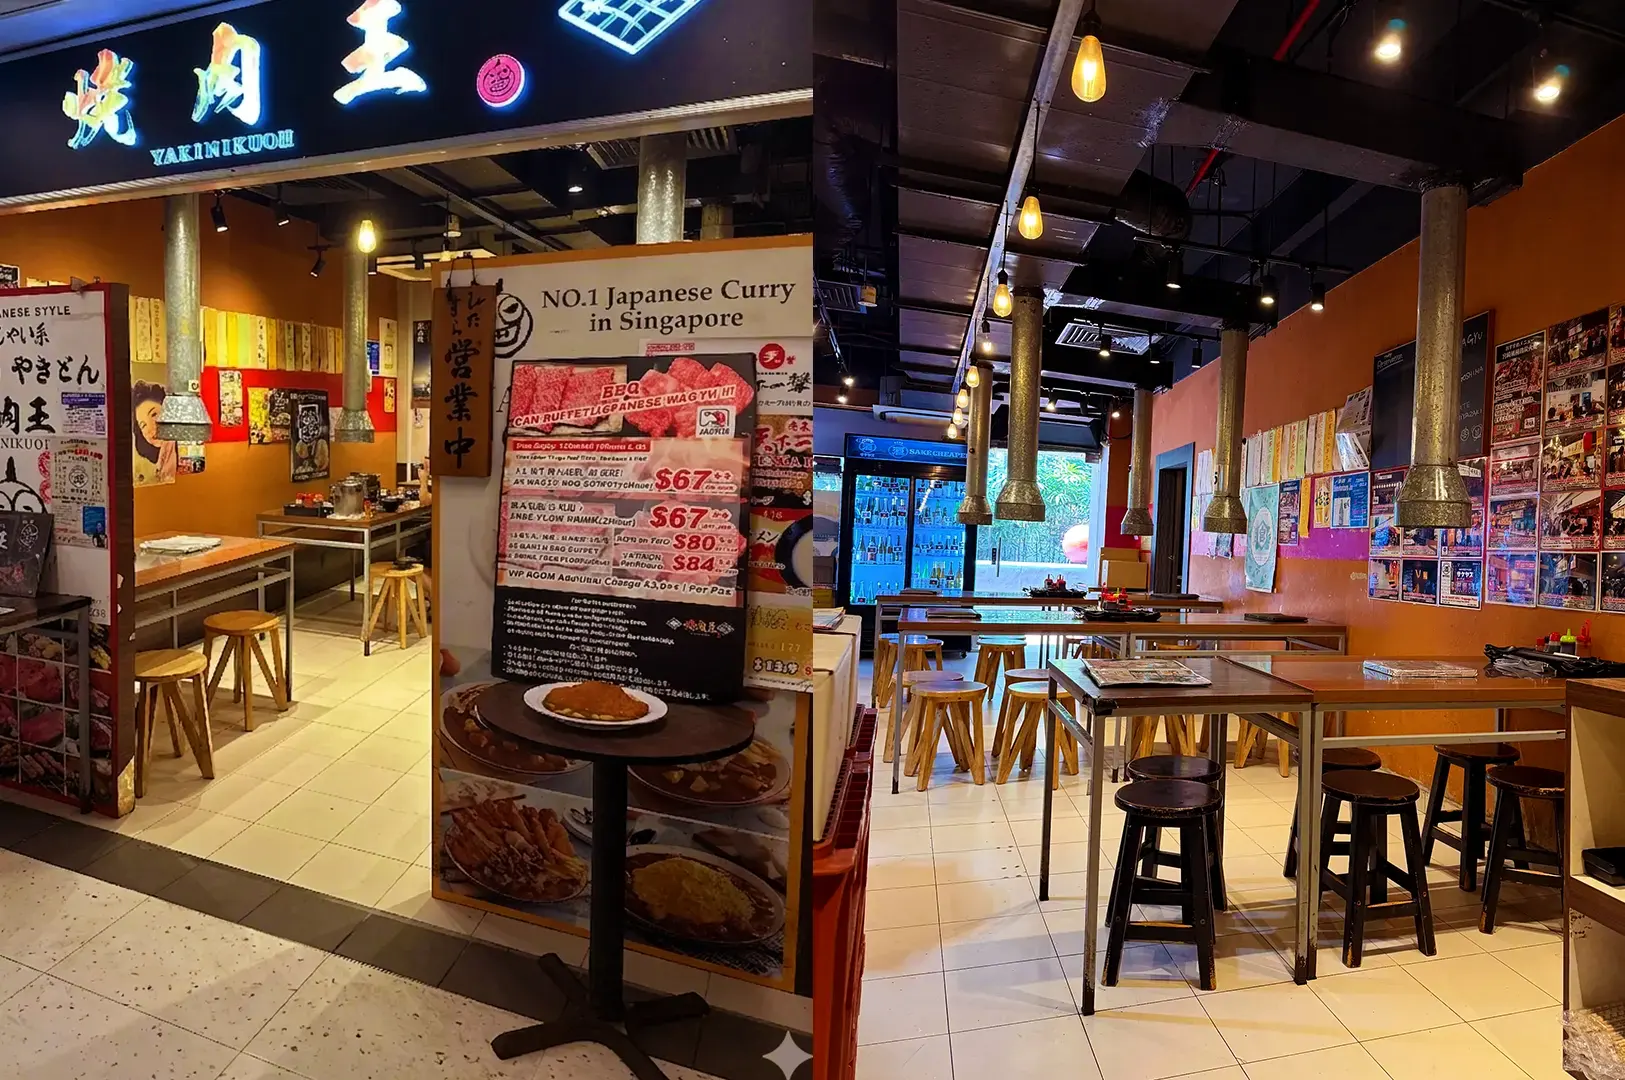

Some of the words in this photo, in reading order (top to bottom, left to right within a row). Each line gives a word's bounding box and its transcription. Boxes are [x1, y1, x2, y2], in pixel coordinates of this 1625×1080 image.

[151, 129, 295, 166] YAKINIKUOH
[542, 288, 598, 308] NO.1
[604, 285, 713, 310] Japanese
[720, 279, 797, 304] Curry
[0, 306, 30, 318] NESE
[589, 313, 612, 332] in
[619, 311, 744, 335] Singapore
[11, 354, 100, 385] やきどん
[444, 338, 480, 469] 営業中
[655, 468, 712, 490] $67
[650, 506, 708, 528] $67
[673, 534, 716, 551] $80
[672, 554, 715, 571] $84
